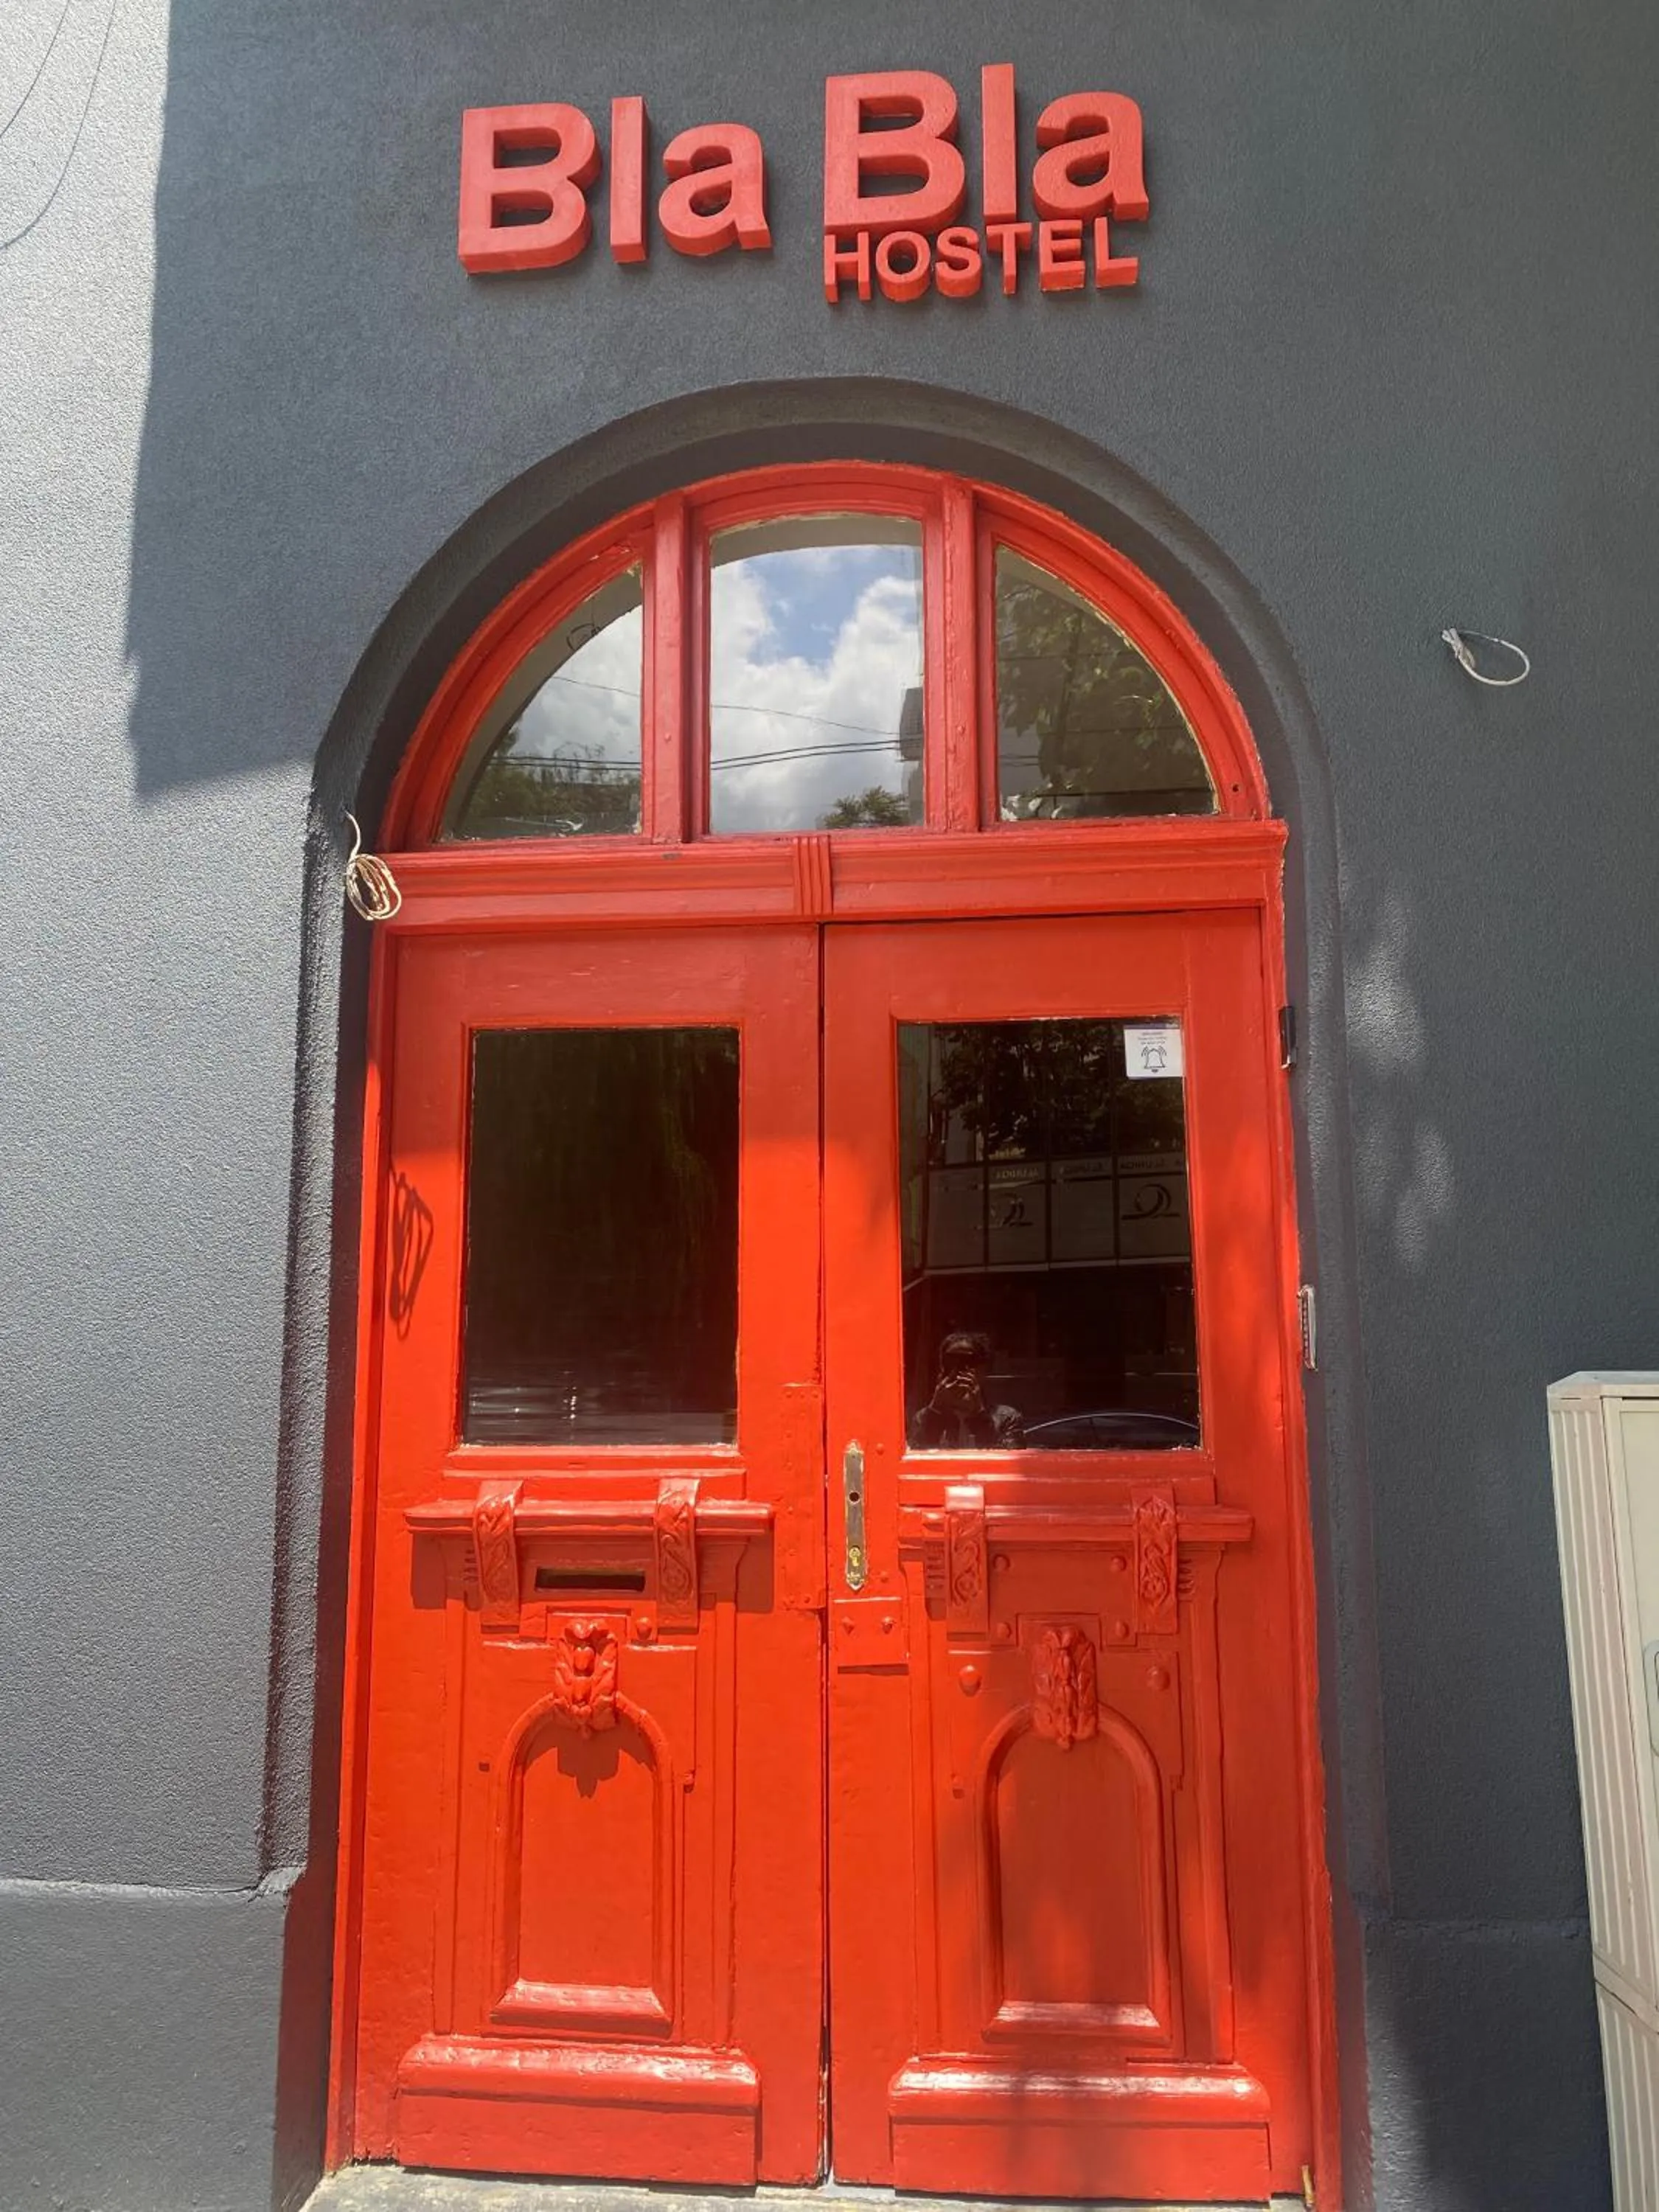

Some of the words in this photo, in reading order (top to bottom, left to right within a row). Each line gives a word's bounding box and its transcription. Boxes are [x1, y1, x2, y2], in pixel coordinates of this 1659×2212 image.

[458, 95, 771, 274] Bla
[823, 62, 1150, 234] Bla
[824, 217, 1140, 303] HOSTEL
